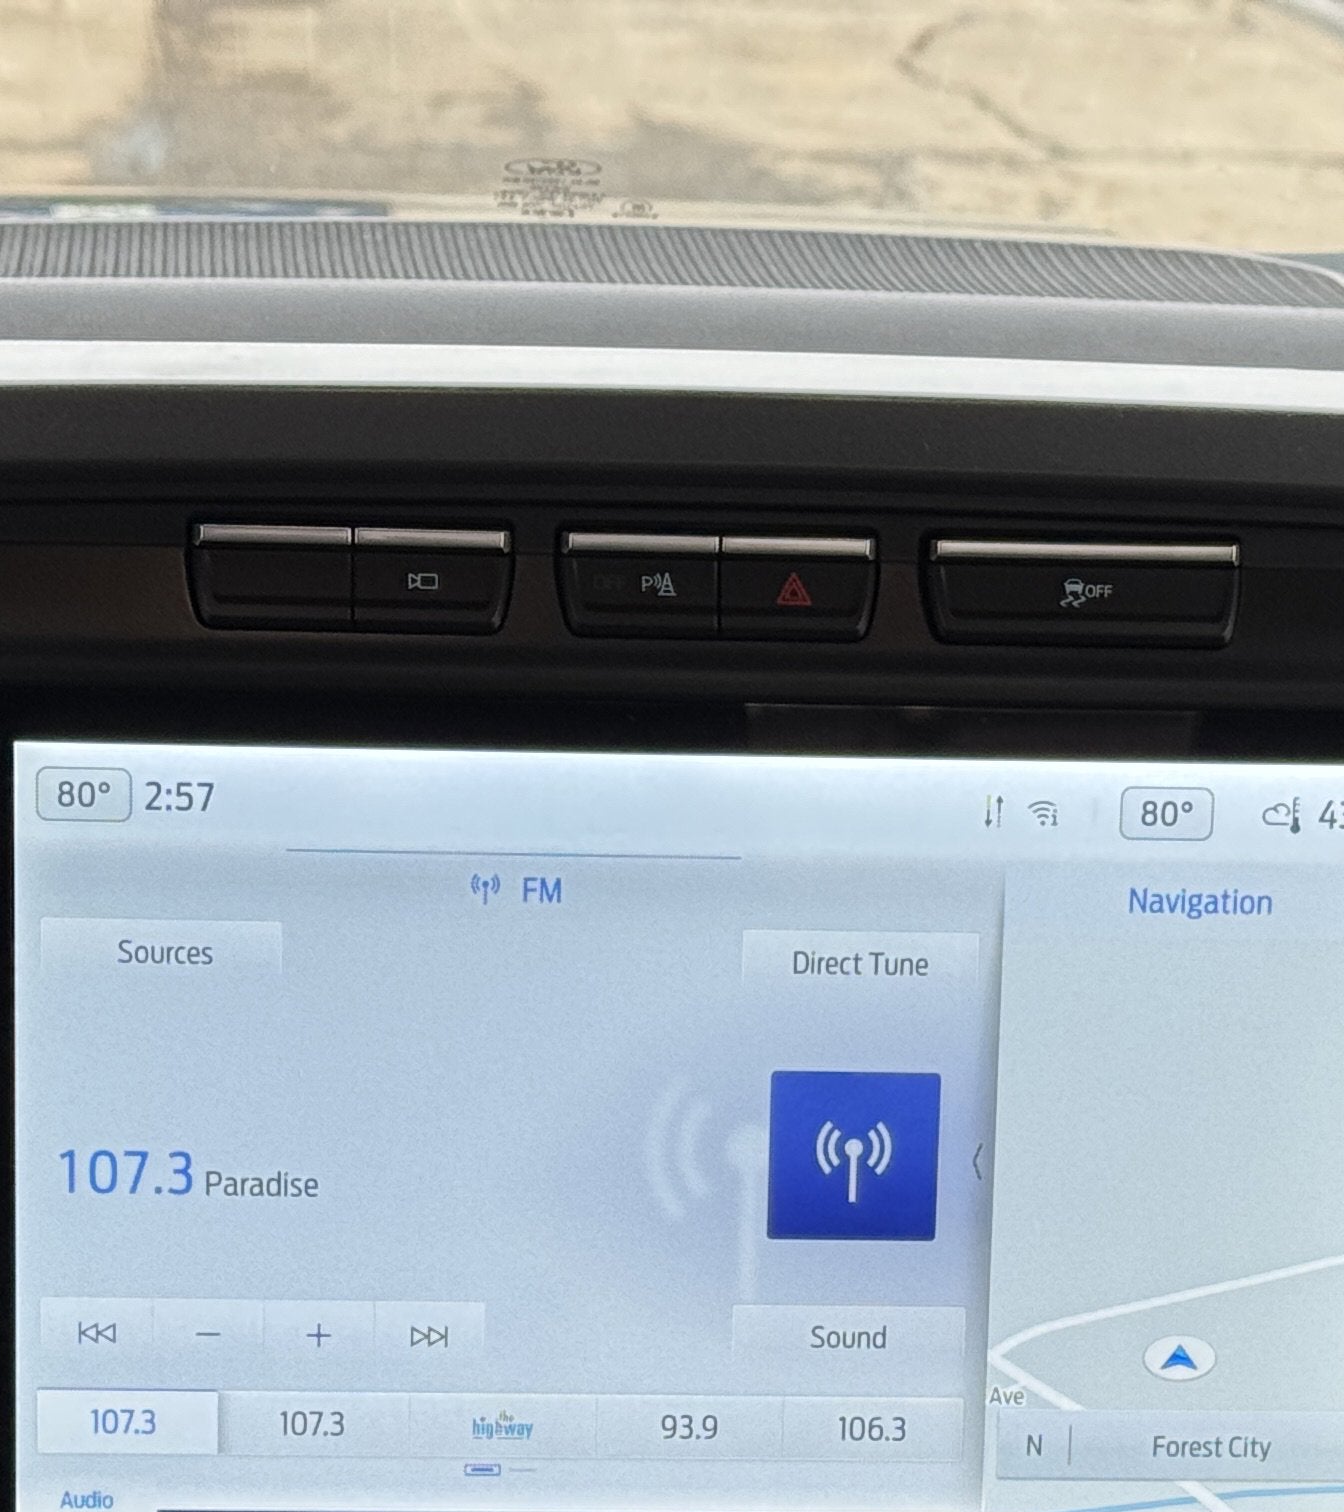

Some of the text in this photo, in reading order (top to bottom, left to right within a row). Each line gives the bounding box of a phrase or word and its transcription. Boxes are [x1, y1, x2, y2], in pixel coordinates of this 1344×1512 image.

[1084, 584, 1113, 598] OFF
[57, 780, 111, 808] 80°
[144, 781, 215, 812] 2:57
[1140, 800, 1194, 827] 80°
[523, 876, 562, 903] FM
[1128, 887, 1273, 920] Navigation
[117, 939, 214, 966] Sources
[793, 950, 929, 977] Direct Tune
[59, 1149, 319, 1198] 107.3 Paradise
[810, 1325, 887, 1350] Sound
[989, 1386, 1025, 1406] Ave
[91, 1408, 156, 1435] 107.3
[280, 1410, 345, 1437] 107.3
[472, 1416, 534, 1440] highway
[661, 1414, 718, 1440] 93.9
[838, 1416, 906, 1442] 106.3
[1026, 1434, 1043, 1457] N
[1152, 1435, 1272, 1463] Forest City
[60, 1490, 114, 1510] Audio
